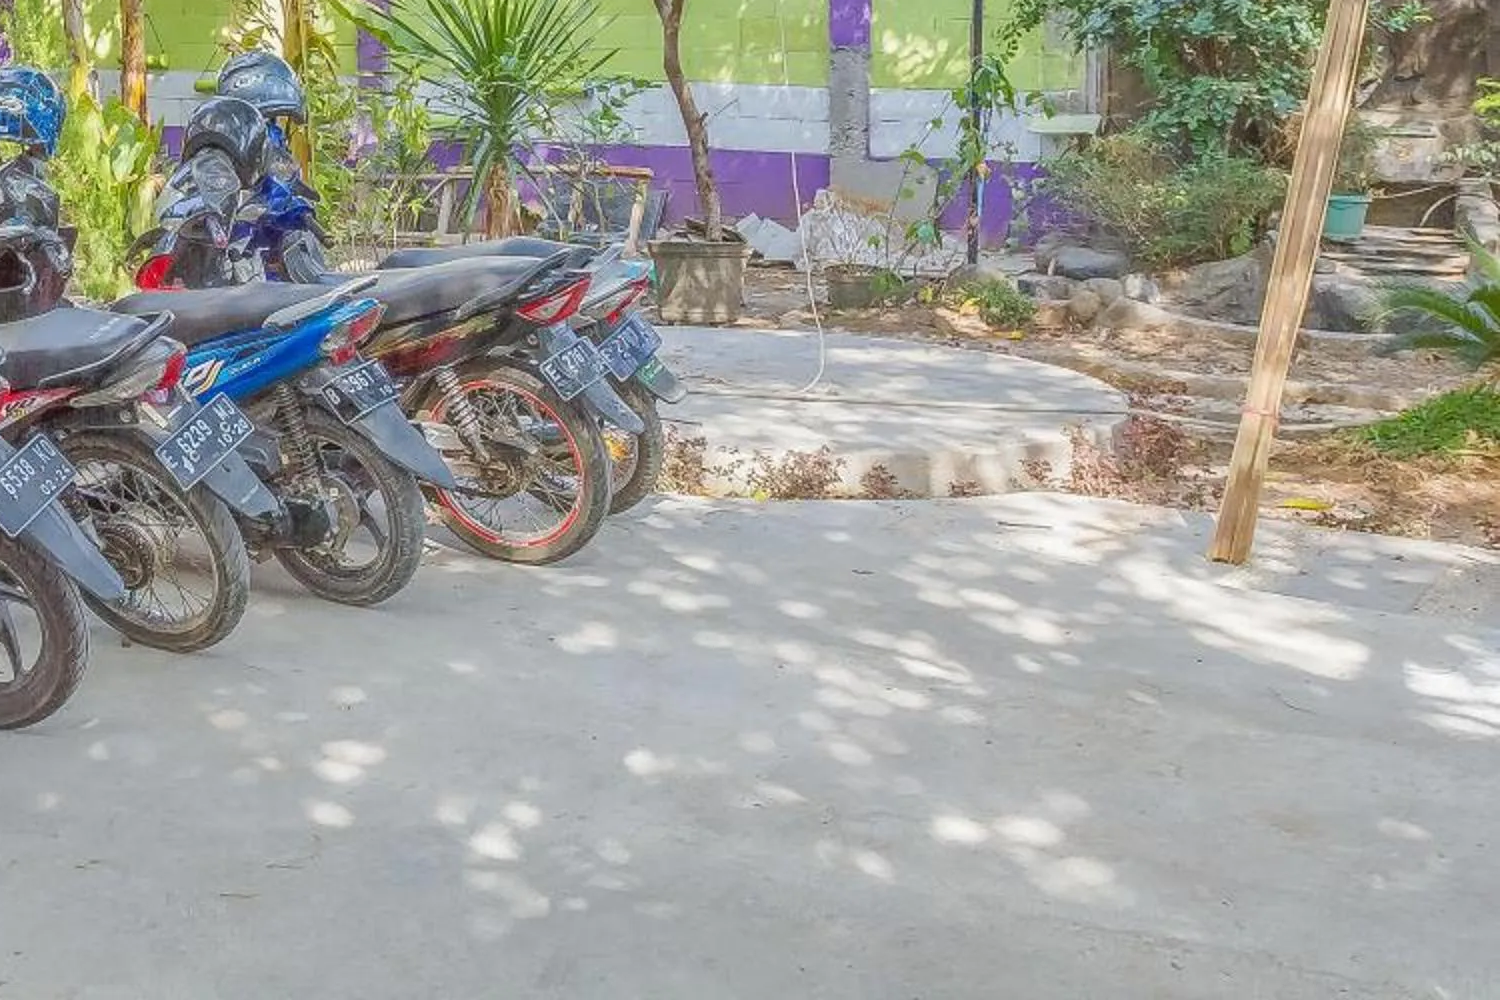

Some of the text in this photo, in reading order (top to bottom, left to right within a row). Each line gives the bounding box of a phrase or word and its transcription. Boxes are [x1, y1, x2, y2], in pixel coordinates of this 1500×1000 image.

[545, 363, 561, 381] E
[161, 449, 179, 469] E
[0, 457, 35, 496] 6538
